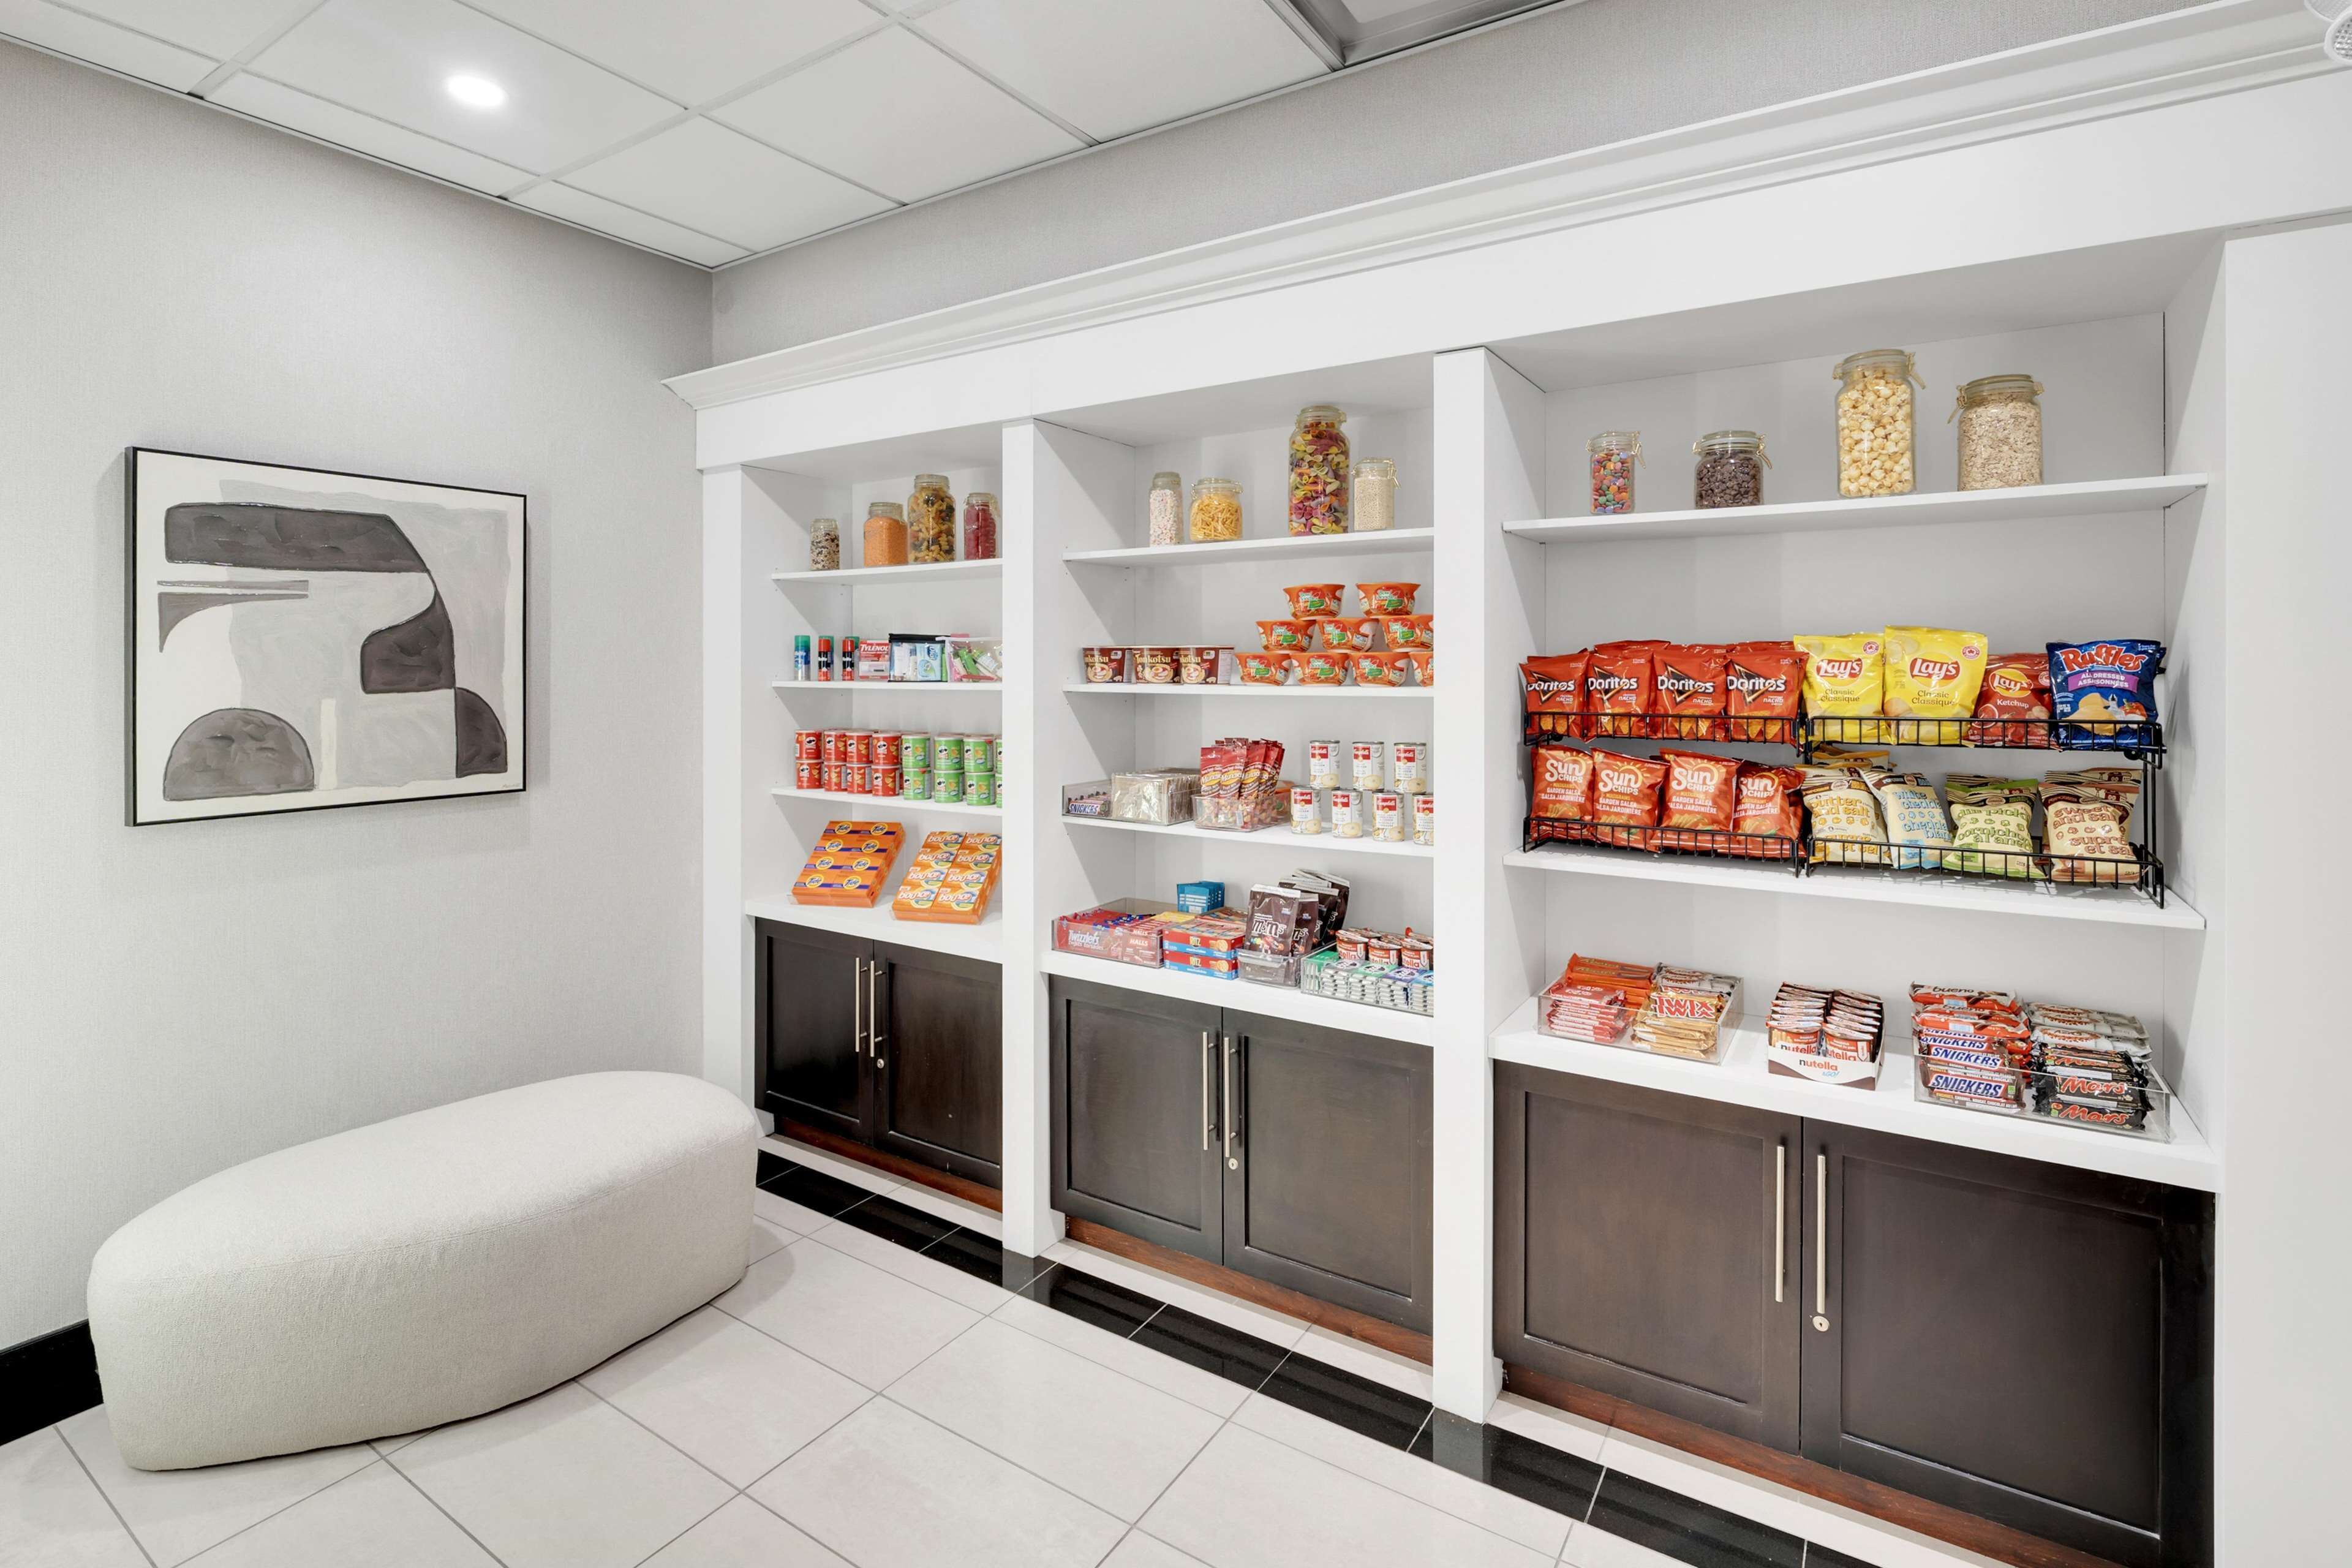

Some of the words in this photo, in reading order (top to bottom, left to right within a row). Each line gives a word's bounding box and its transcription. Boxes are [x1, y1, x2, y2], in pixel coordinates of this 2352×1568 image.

[1136, 653, 1171, 664] Tonkotsu
[2059, 643, 2149, 674] Ruffles
[1819, 659, 1862, 679] Lay's
[1912, 658, 1958, 680] Lay's
[1588, 677, 1638, 690] Doritos
[1657, 676, 1714, 693] Doritos
[1727, 675, 1787, 691] Doritos
[1911, 697, 1955, 707] Classique
[1997, 699, 2029, 709] Ketchup
[1545, 759, 1585, 782] Sun
[1558, 774, 1583, 783] CHIPS
[1671, 767, 1717, 790] Sun
[1599, 769, 1643, 792] Sun
[1687, 783, 1715, 793] CHIPS
[1612, 785, 1639, 795] CHIPS
[1070, 804, 1099, 814] SNICKERS
[2053, 813, 2086, 829] and
[2084, 844, 2105, 854] et
[1651, 995, 1716, 1019] TWIX
[1921, 1036, 1986, 1049] SNICKERS
[1826, 1049, 1857, 1061] utella
[1932, 1047, 2001, 1068] SNICKERS
[1800, 1059, 1838, 1071] nutella
[1931, 1075, 2003, 1096] SNICKERS
[2061, 1076, 2125, 1095] Mars
[2059, 1104, 2130, 1125] Mars
